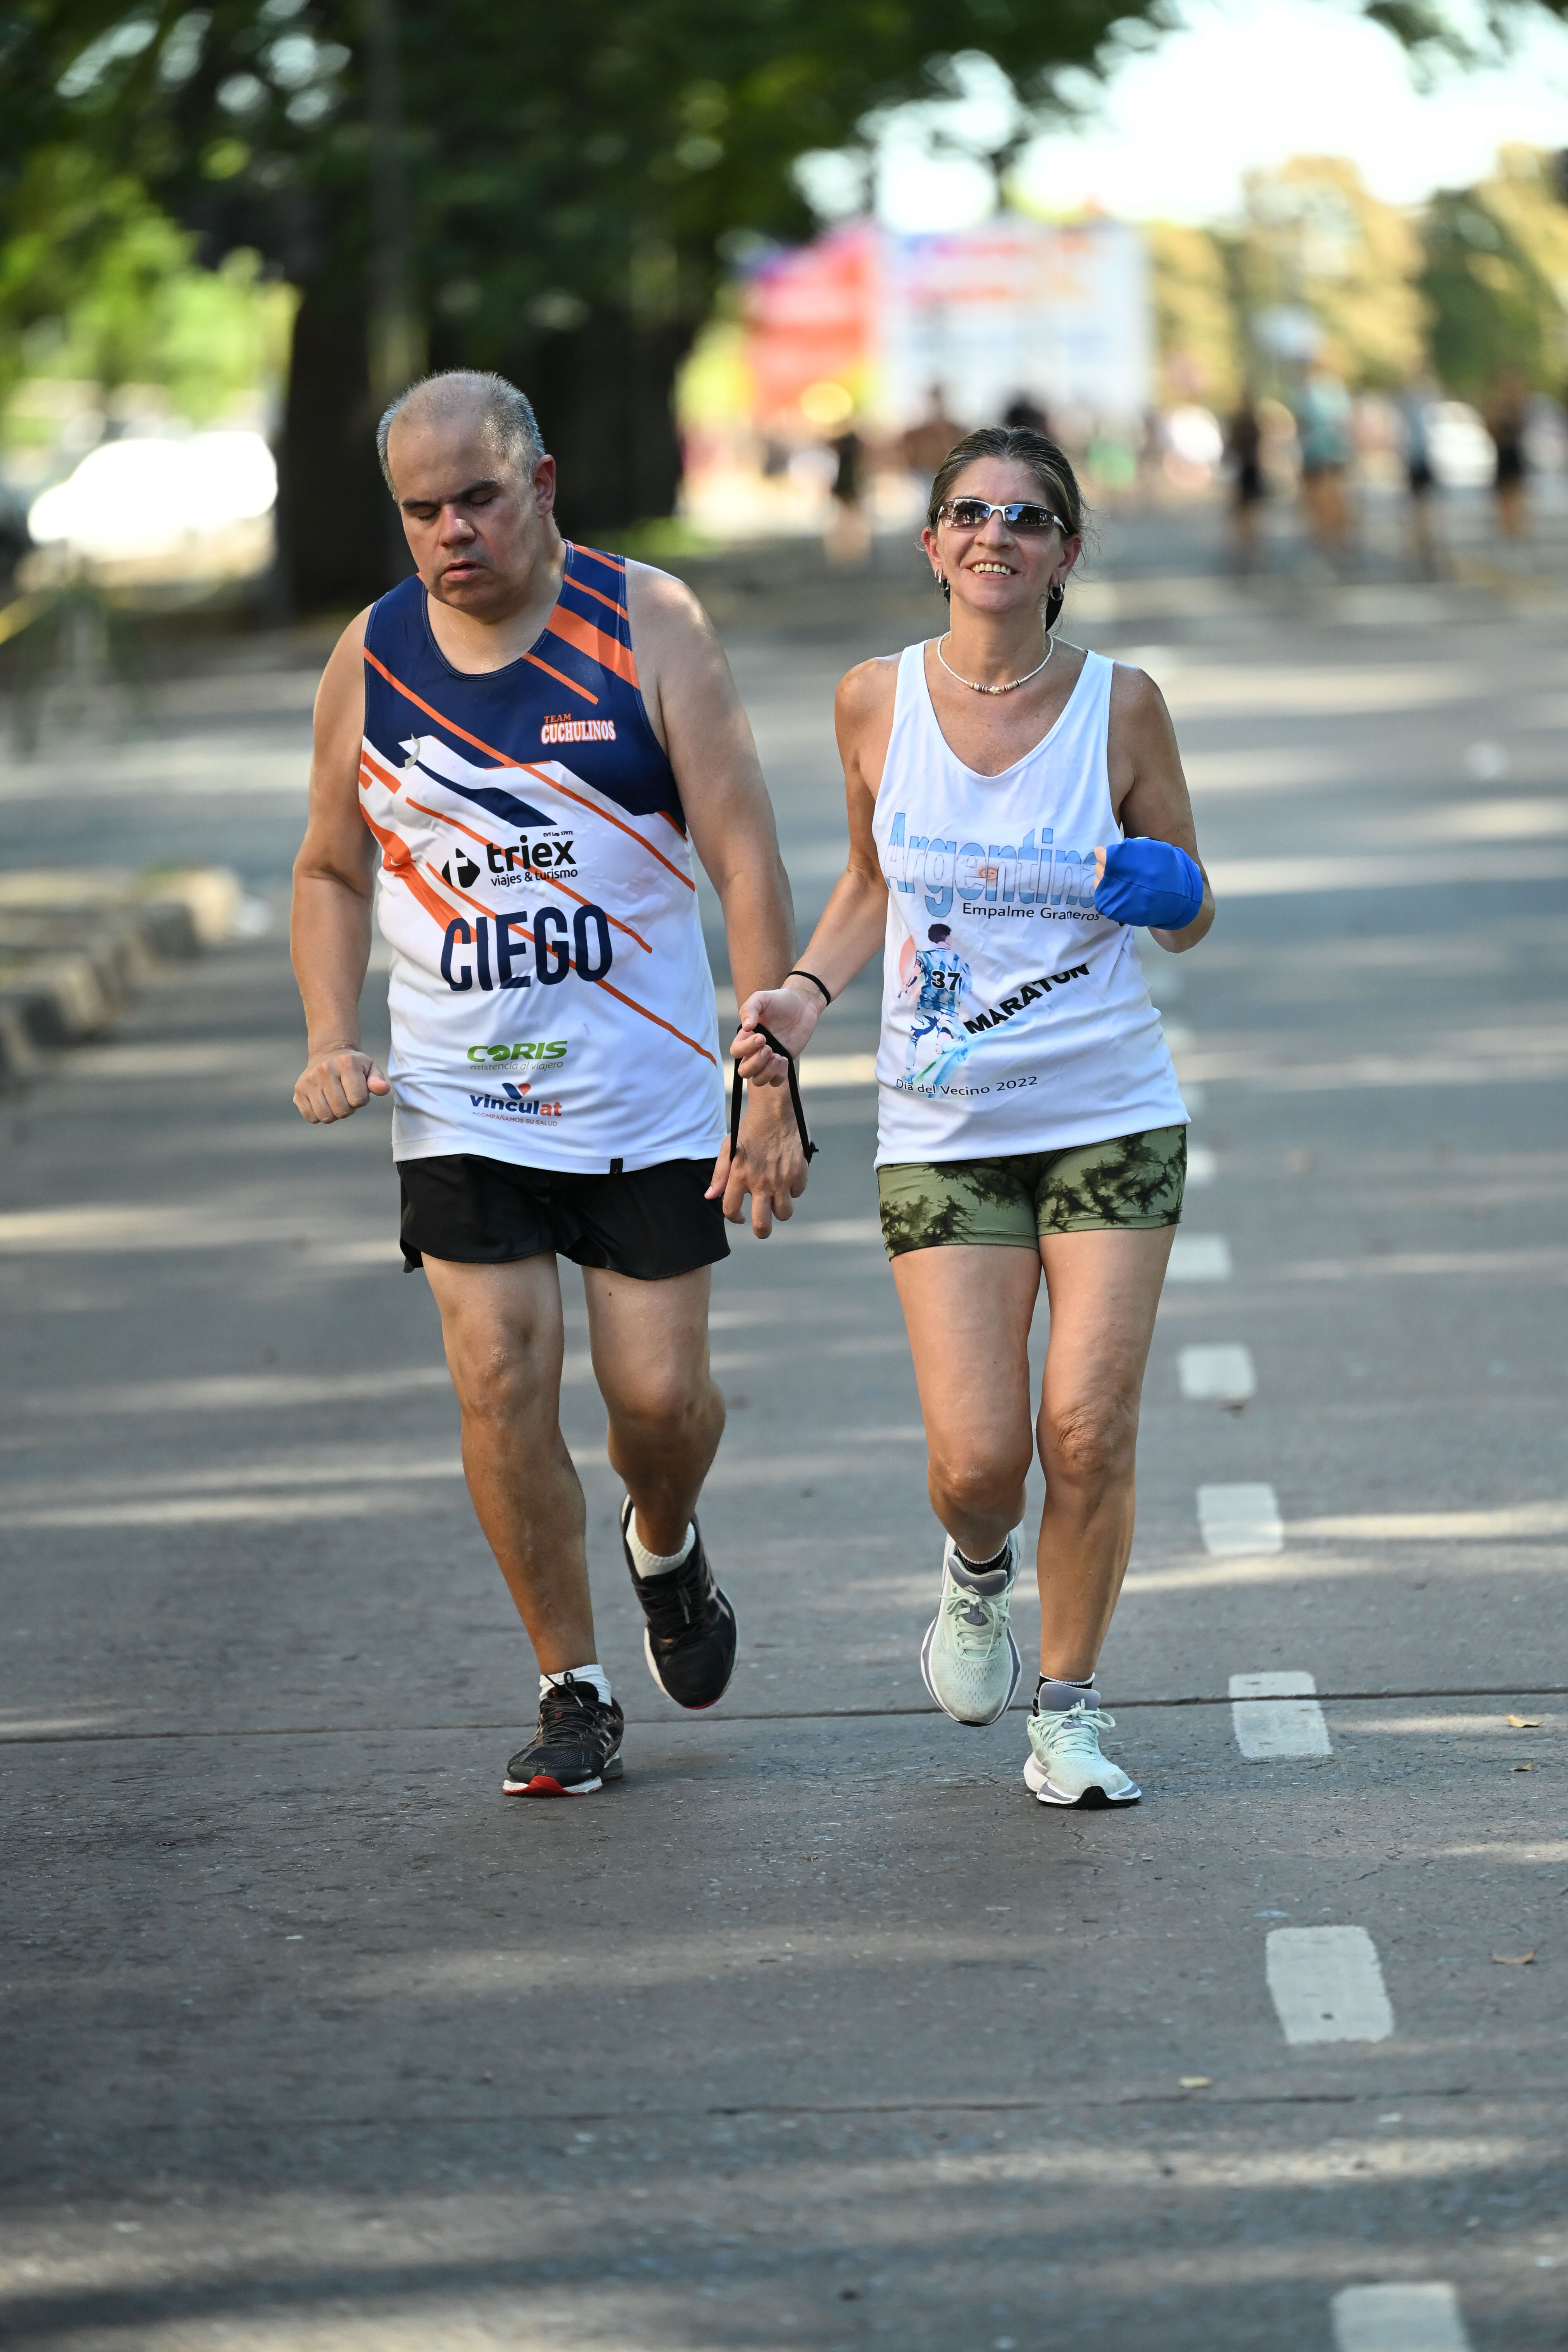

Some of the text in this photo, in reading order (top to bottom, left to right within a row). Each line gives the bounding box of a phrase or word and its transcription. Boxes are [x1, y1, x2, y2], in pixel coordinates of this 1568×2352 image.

[544, 713, 571, 723] TEAM
[541, 720, 616, 744] CUCHULINOS
[486, 835, 576, 873] triex
[491, 869, 578, 887] viajes & turismo
[963, 903, 1099, 921] Empalme Graneros
[441, 904, 612, 991] CIEGO
[931, 971, 960, 991] 37
[467, 1041, 568, 1062] CORIS
[470, 1061, 563, 1071] asistencia al viajero
[896, 1076, 1038, 1095] Día del Vecino 2022
[470, 1094, 562, 1116] vinculat
[472, 1111, 524, 1123] ACOMPAÑAMOS
